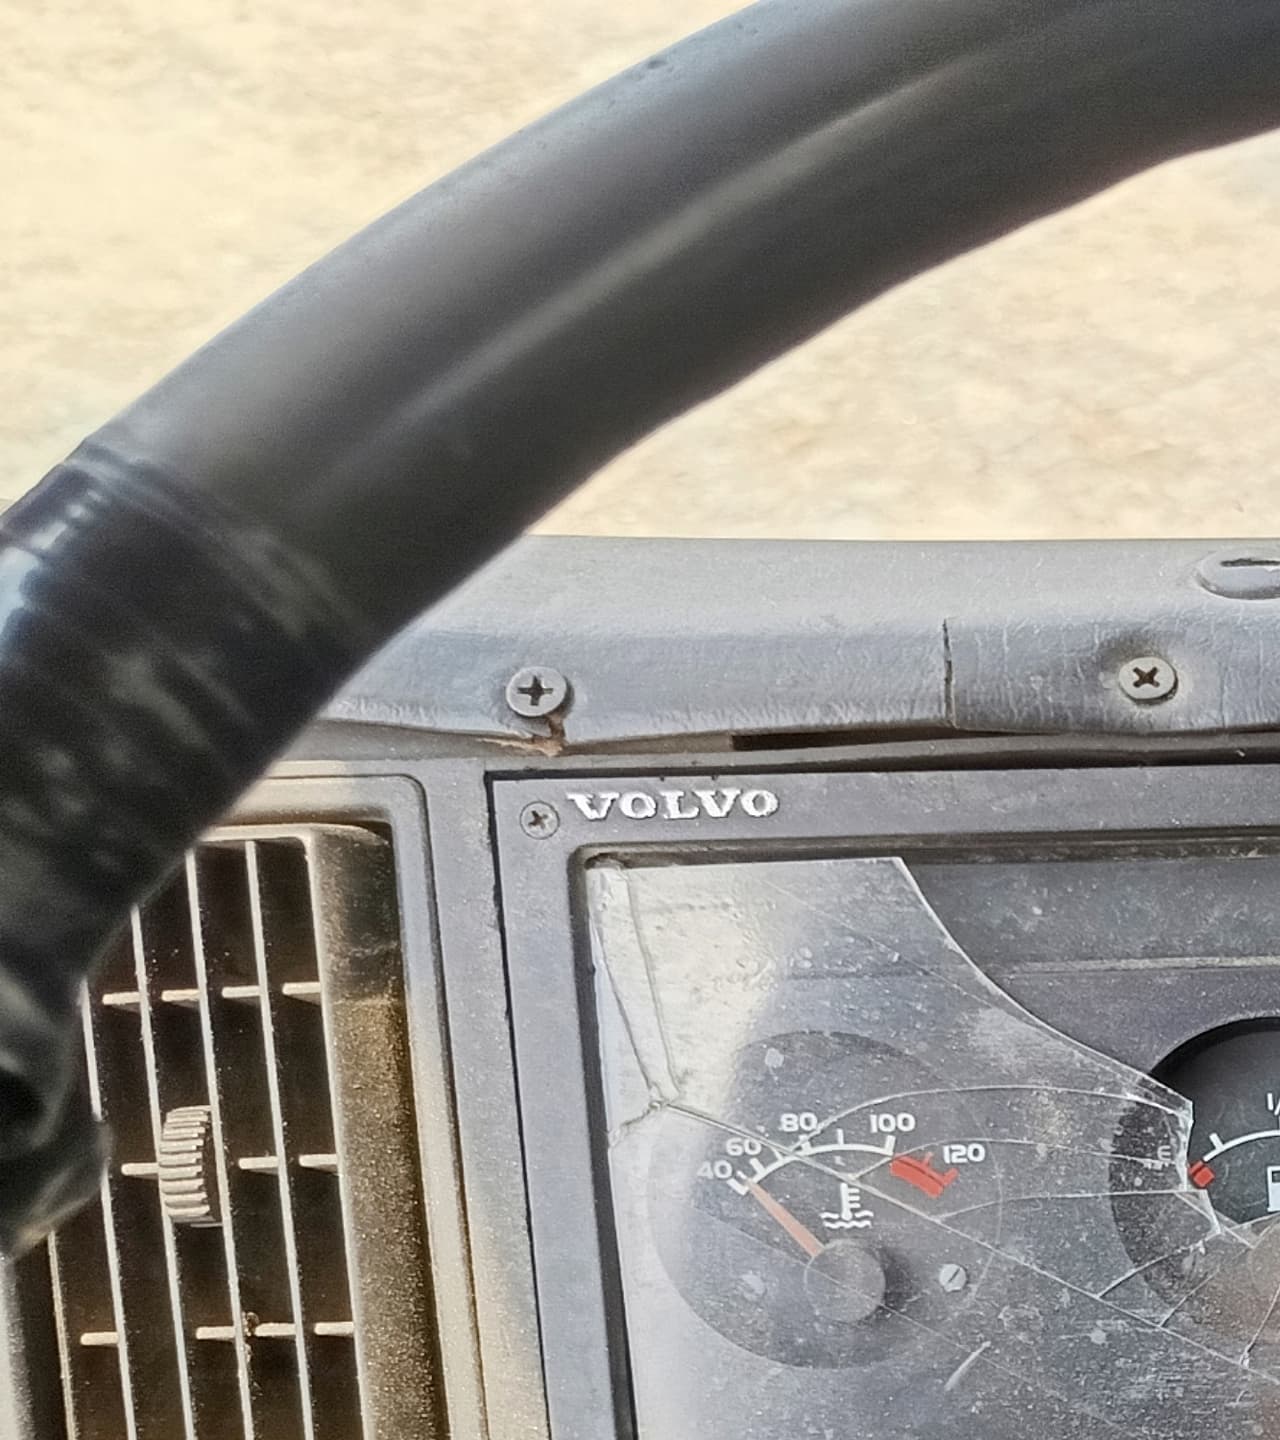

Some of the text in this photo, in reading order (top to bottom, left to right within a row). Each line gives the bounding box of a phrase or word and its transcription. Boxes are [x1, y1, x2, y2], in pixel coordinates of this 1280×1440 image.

[566, 788, 780, 820] VOLVO
[780, 1112, 818, 1132] 80
[869, 1113, 916, 1133] 100
[726, 1137, 762, 1156] 60
[943, 1143, 986, 1163] 120
[697, 1160, 732, 1180] 40
